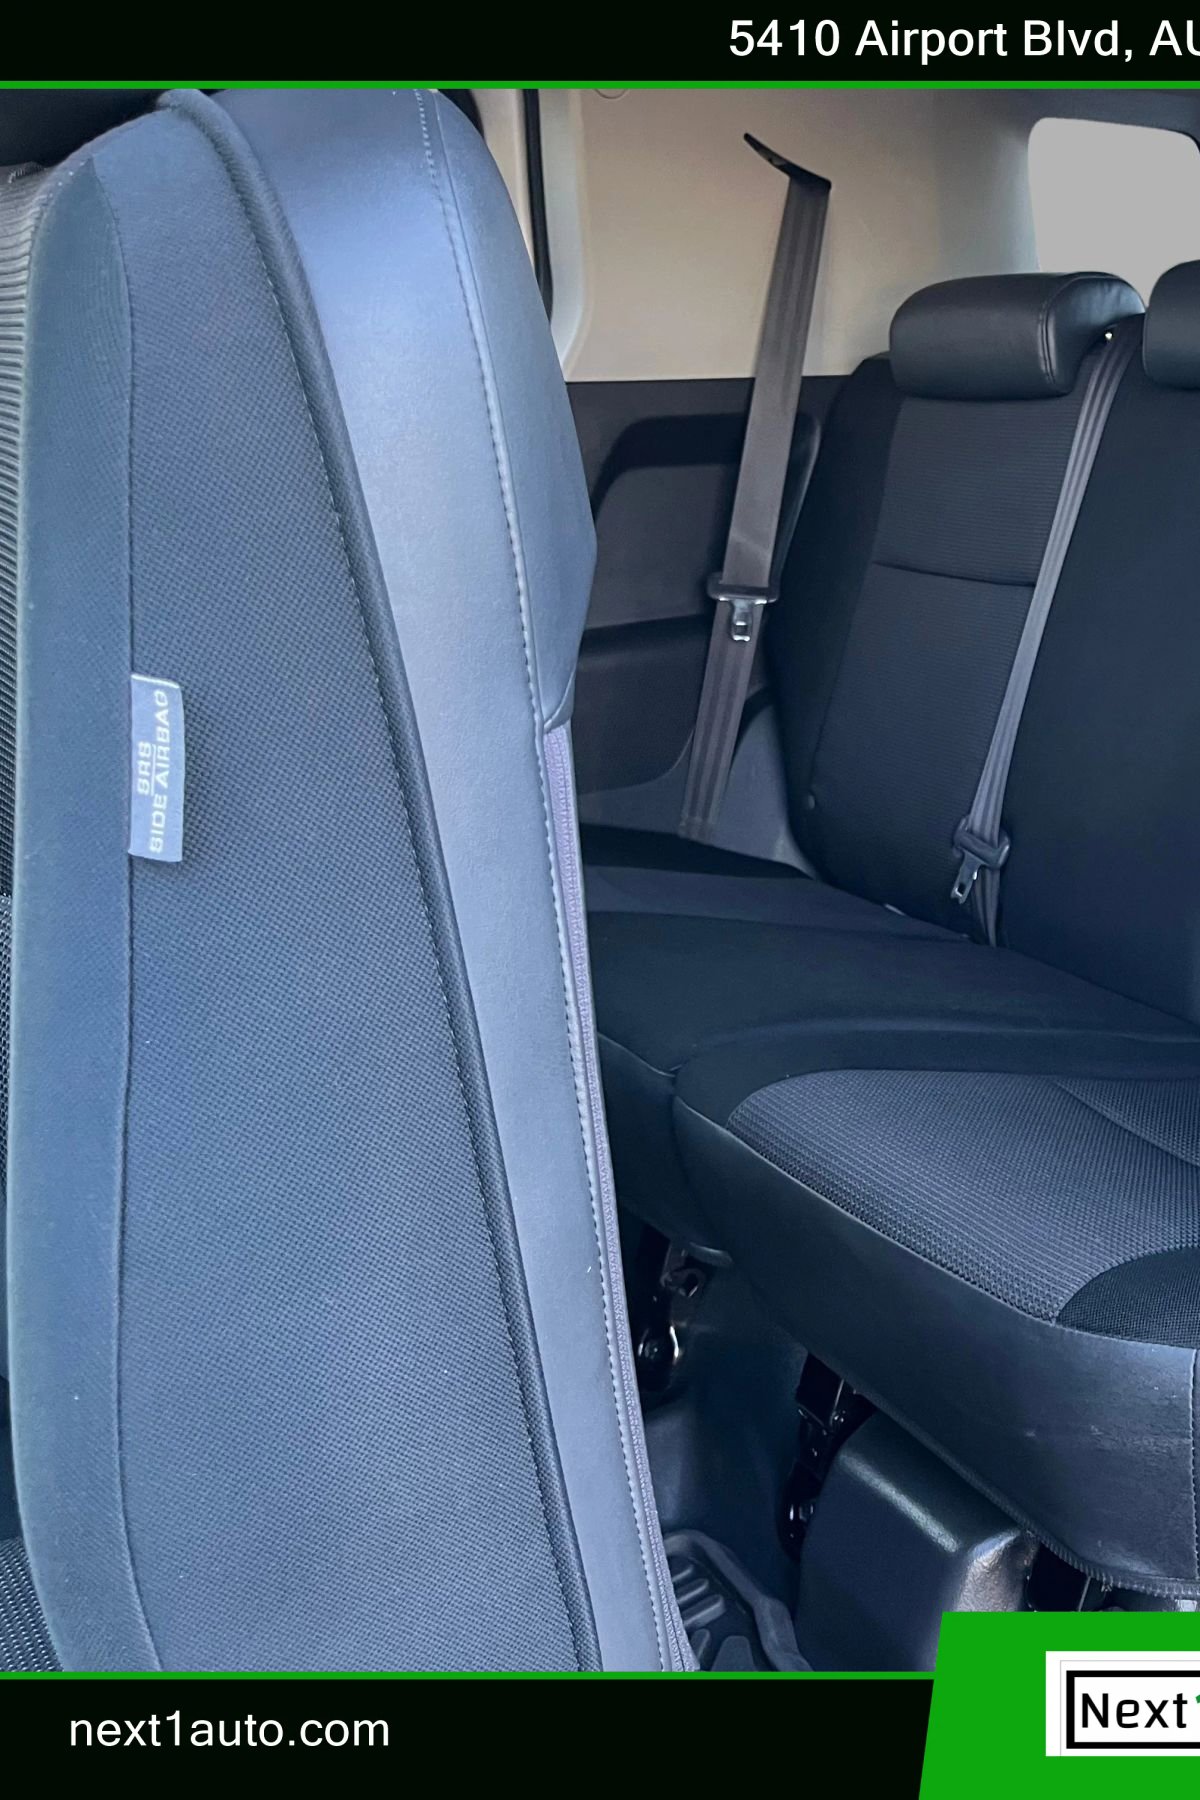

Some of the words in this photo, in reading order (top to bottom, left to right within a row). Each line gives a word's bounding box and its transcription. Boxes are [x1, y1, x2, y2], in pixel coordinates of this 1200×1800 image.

[137, 741, 151, 795] SRS
[154, 690, 171, 789] AIRBAG
[149, 794, 167, 853] SIDE
